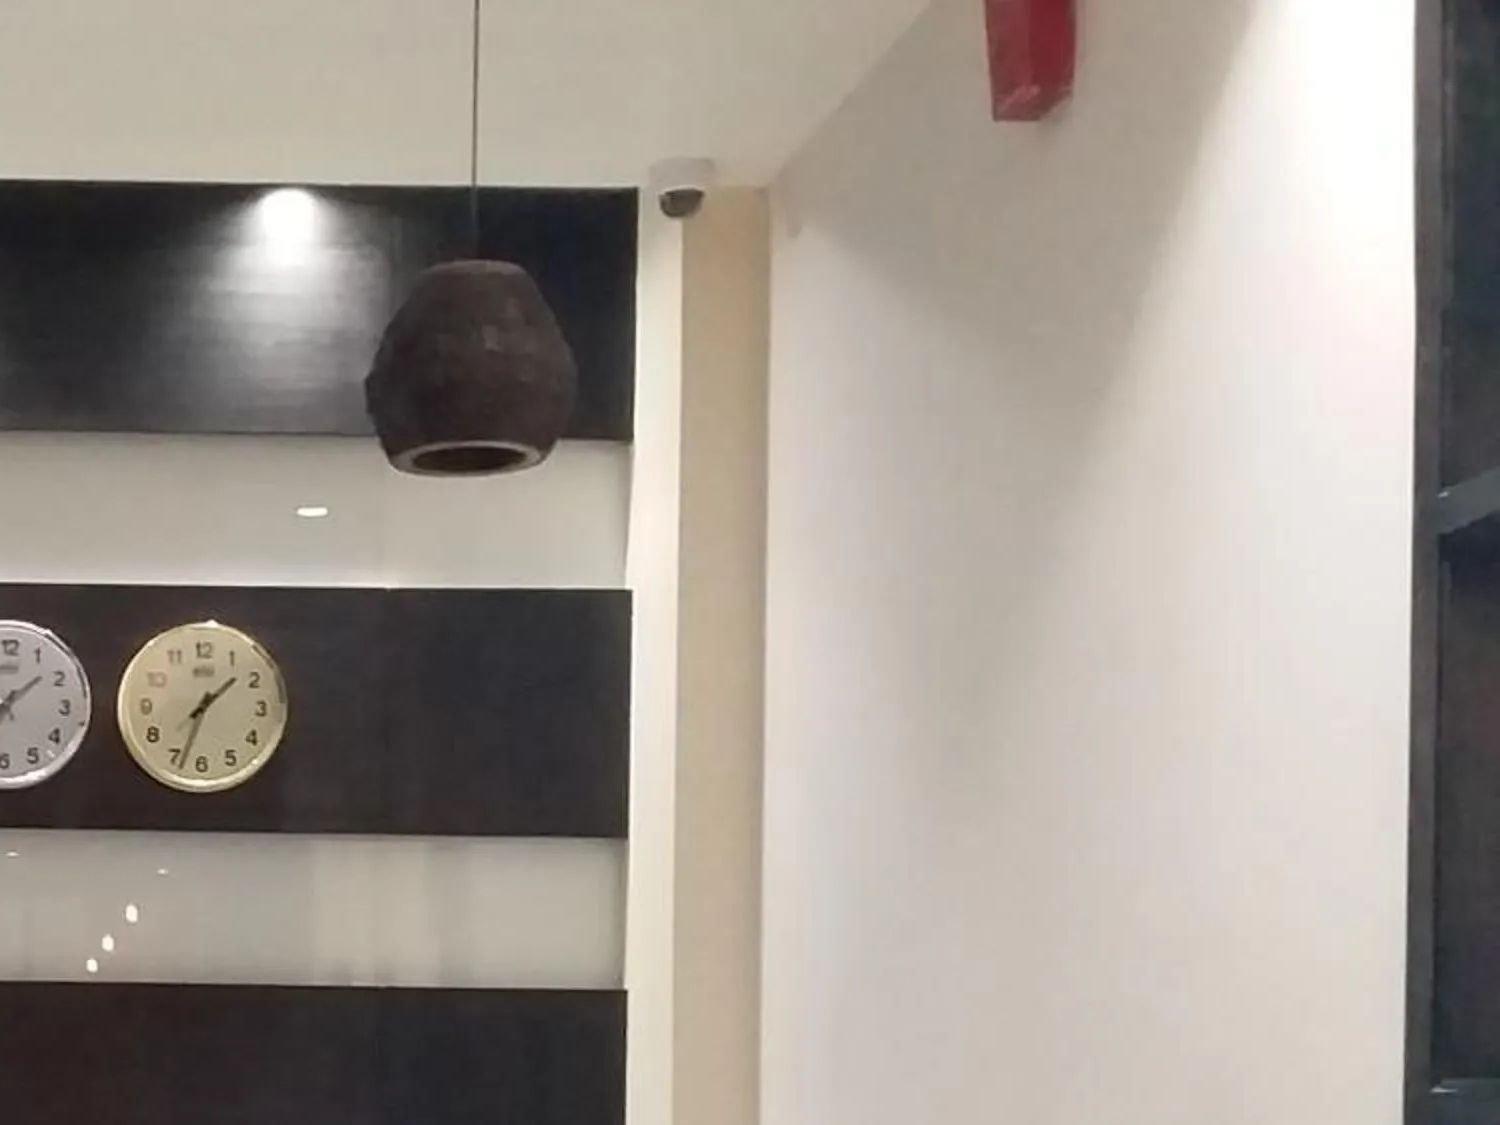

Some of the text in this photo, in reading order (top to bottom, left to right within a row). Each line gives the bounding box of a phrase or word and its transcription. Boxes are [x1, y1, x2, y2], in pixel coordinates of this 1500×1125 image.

[1, 639, 19, 655] 12
[196, 642, 213, 658] 12
[35, 648, 41, 663] 1
[168, 650, 182, 664] 11
[229, 650, 235, 666] 1
[53, 671, 66, 686] 2
[248, 672, 260, 688] 2
[59, 700, 71, 716] 3
[140, 698, 152, 715] 9
[255, 700, 267, 717] 3
[48, 728, 61, 743] 4
[146, 727, 160, 743] 8
[245, 729, 258, 746] 4
[27, 747, 39, 764] 5
[169, 748, 181, 765] 7
[225, 750, 237, 766] 5
[196, 756, 208, 772] 6
